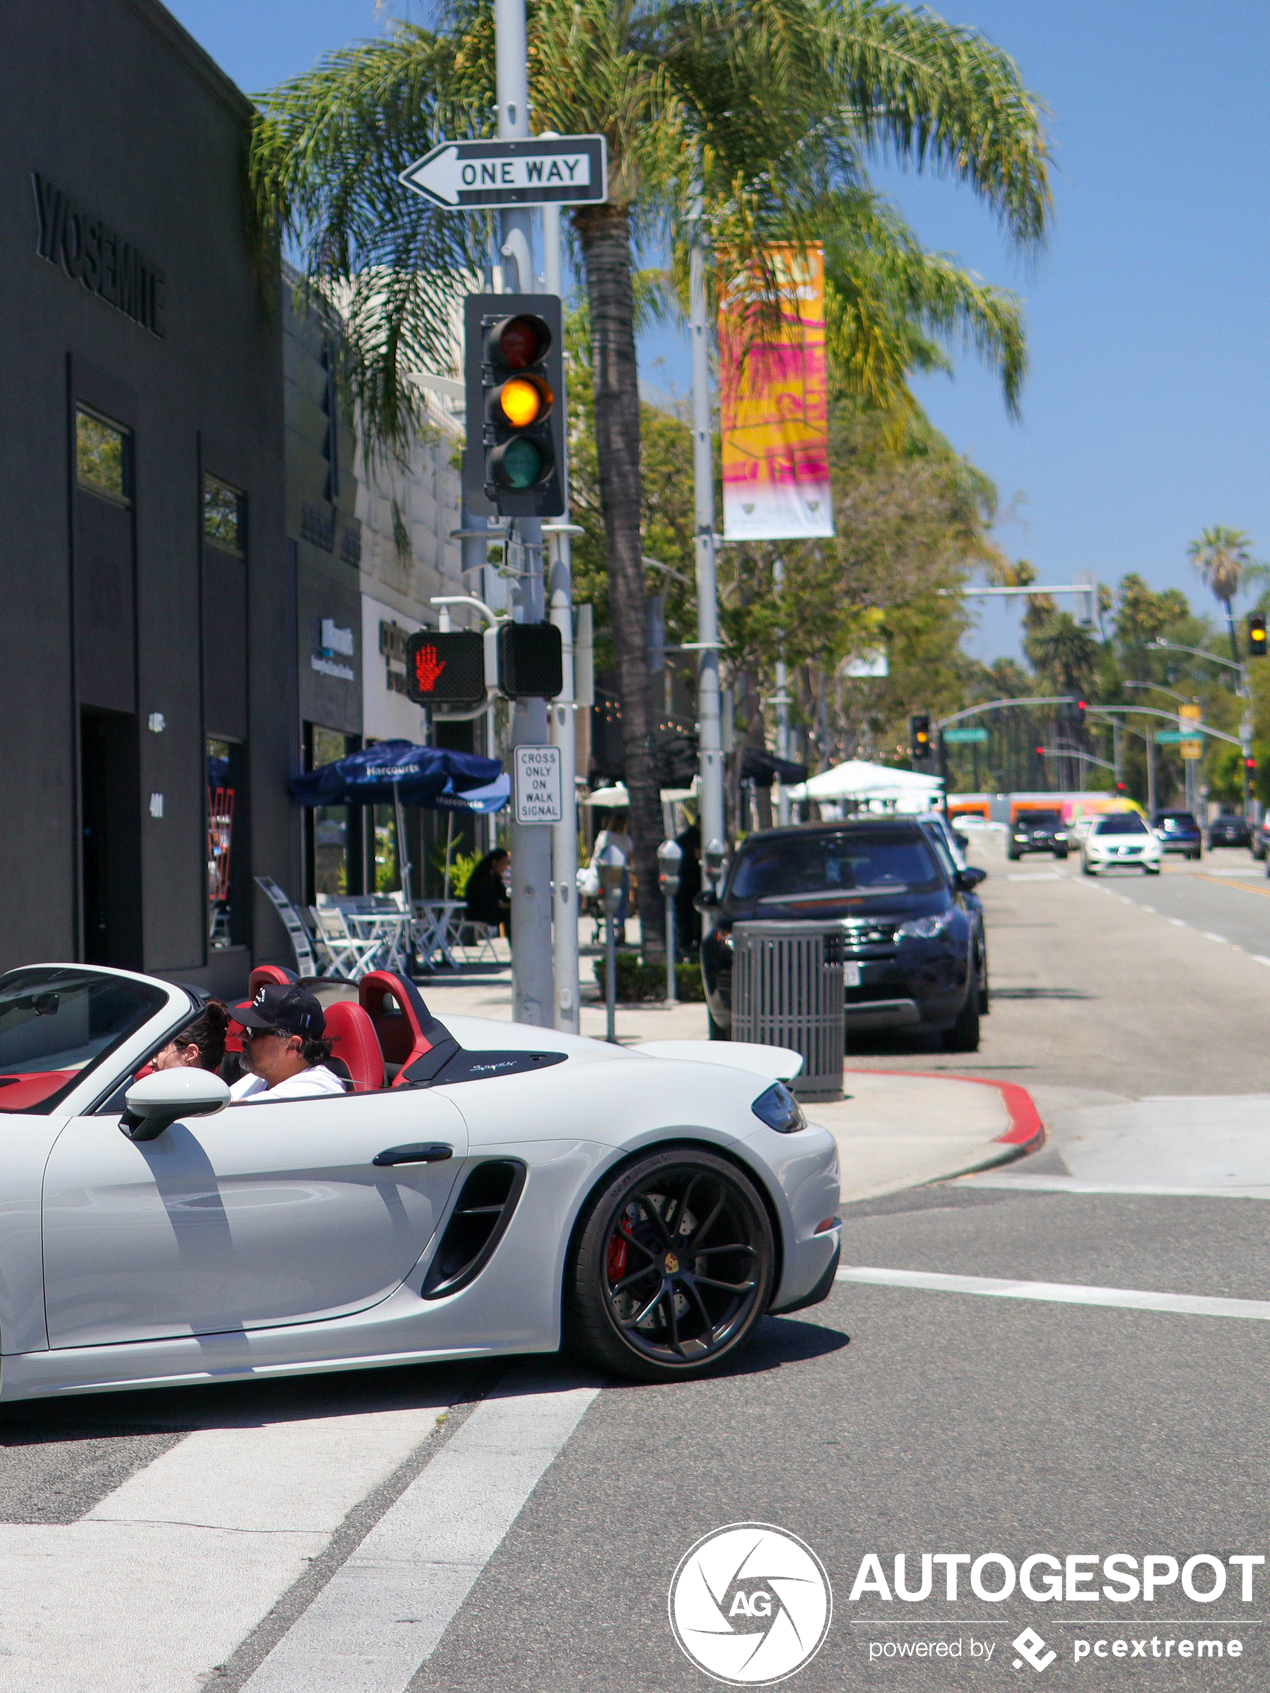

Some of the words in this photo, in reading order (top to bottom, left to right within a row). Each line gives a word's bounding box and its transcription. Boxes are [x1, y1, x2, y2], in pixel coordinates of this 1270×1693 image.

[462, 163, 514, 185] ONE
[525, 159, 579, 182] WAY
[521, 753, 556, 764] CROSS
[366, 763, 420, 776] Harcourts
[526, 766, 551, 777] ONLY
[532, 780, 546, 790] ON
[526, 793, 553, 803] WALK
[522, 806, 558, 816] SIGNAL
